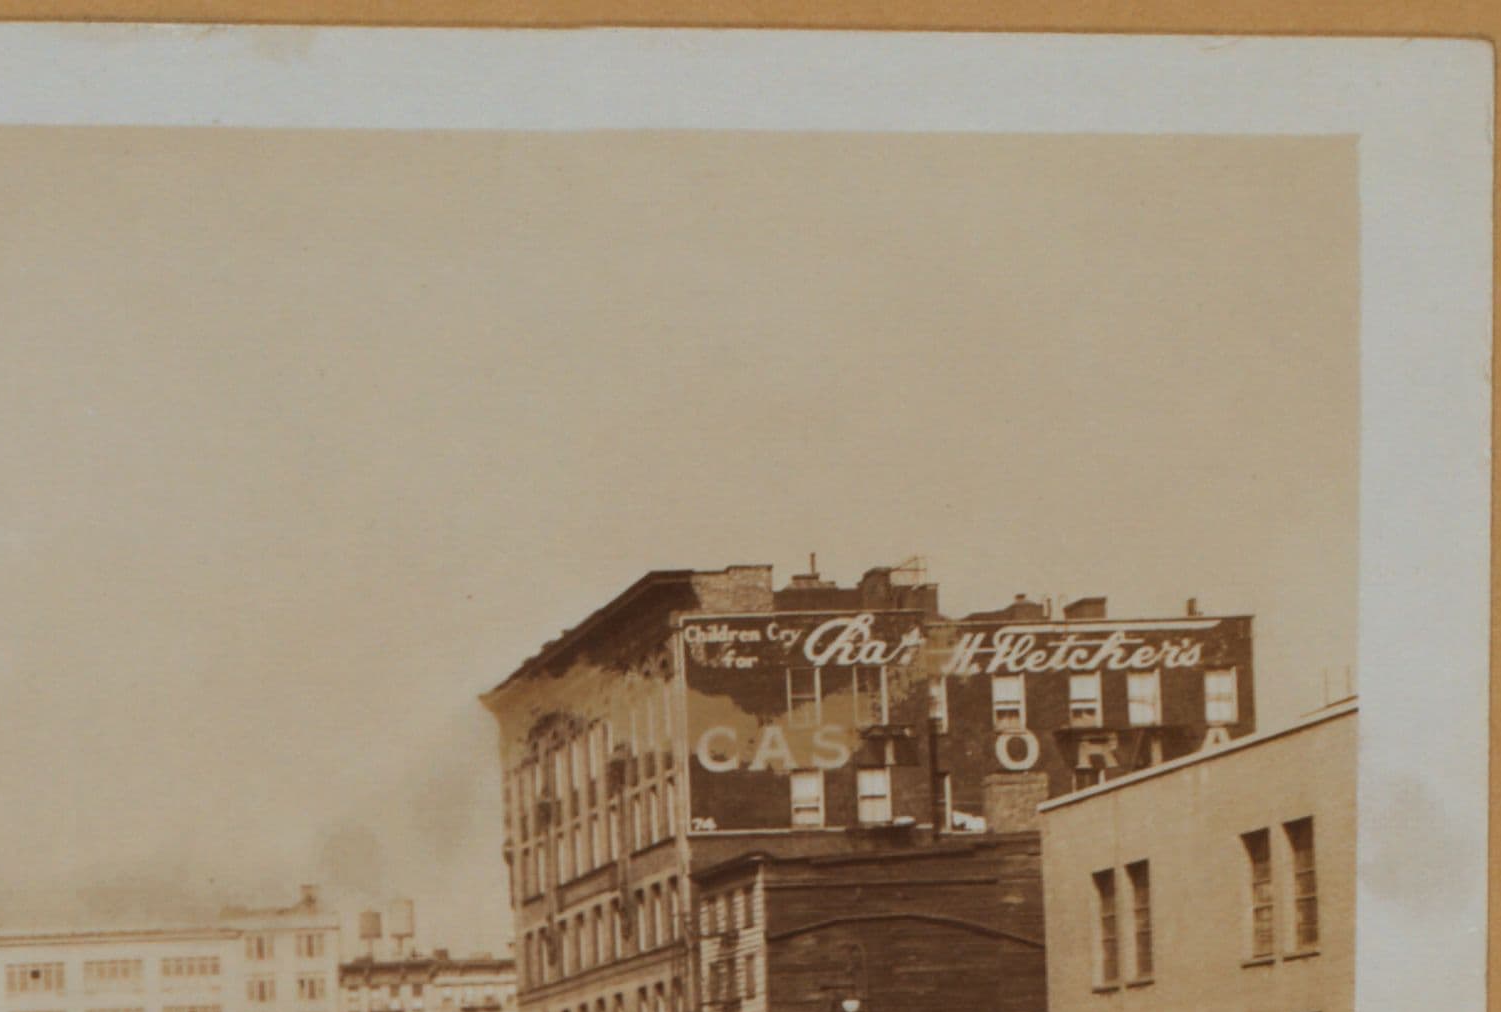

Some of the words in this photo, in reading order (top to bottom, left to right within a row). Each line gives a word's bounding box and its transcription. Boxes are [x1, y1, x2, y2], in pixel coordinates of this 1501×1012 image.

[684, 623, 761, 643] Children
[766, 622, 801, 648] Cry
[721, 651, 758, 669] for
